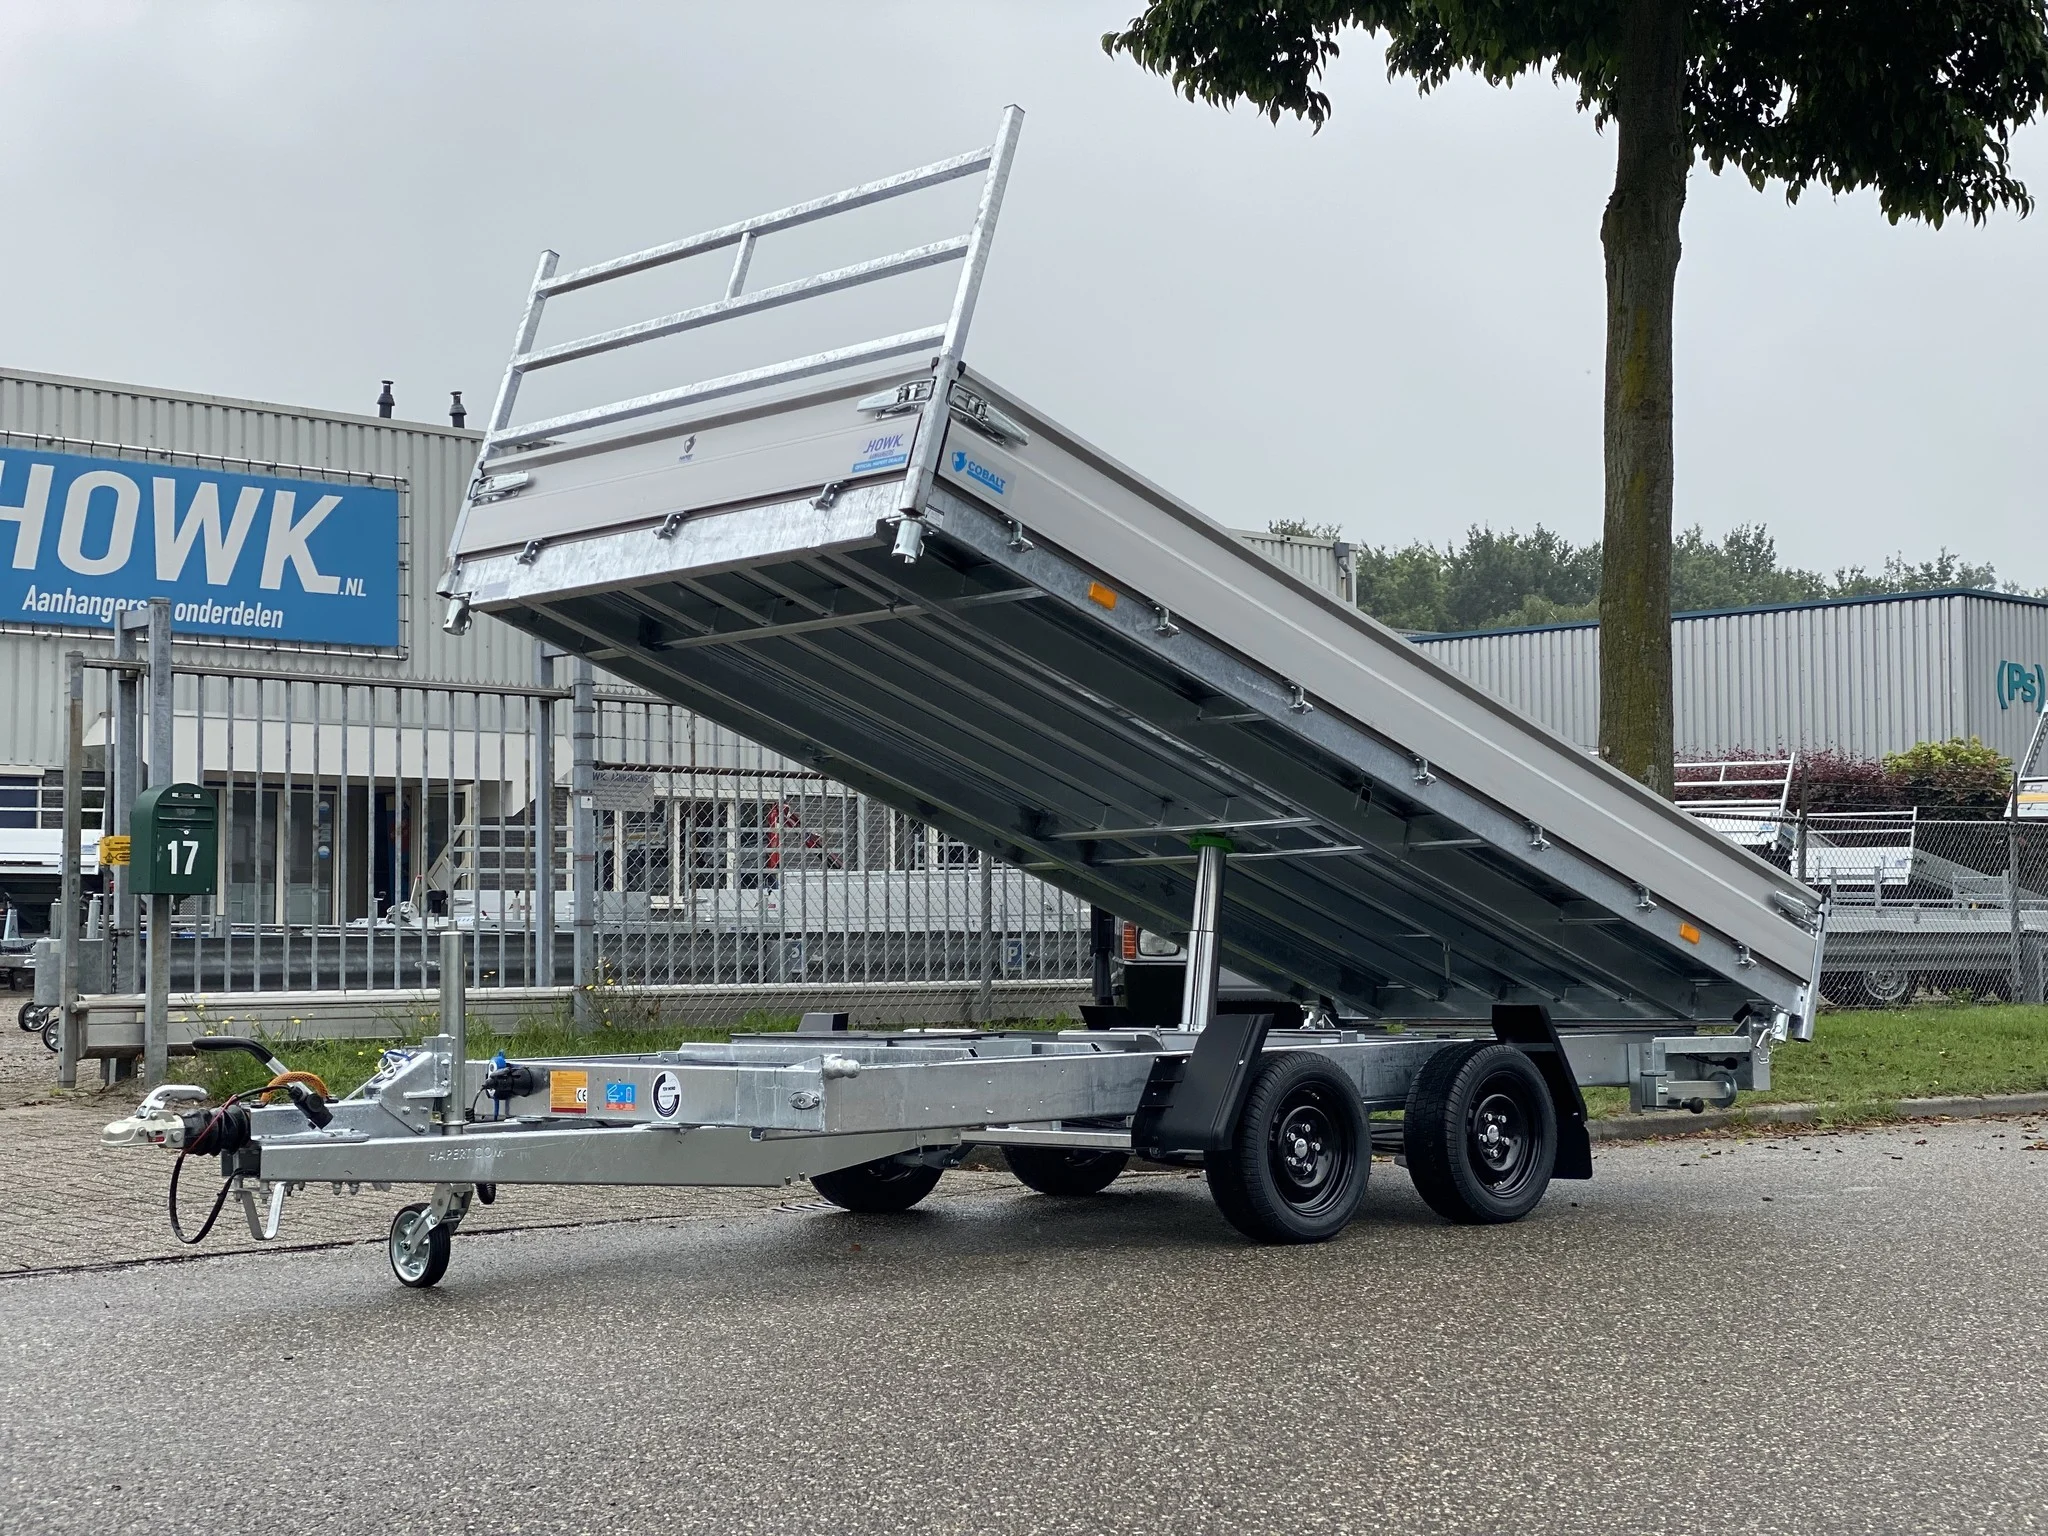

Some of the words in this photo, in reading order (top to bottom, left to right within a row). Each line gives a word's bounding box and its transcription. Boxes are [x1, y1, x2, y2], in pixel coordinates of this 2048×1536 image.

[863, 434, 904, 453] HOWK
[968, 461, 1006, 489] COBALT
[174, 598, 284, 629] onderdelen
[167, 840, 199, 875] 17
[1008, 947, 1018, 962] P
